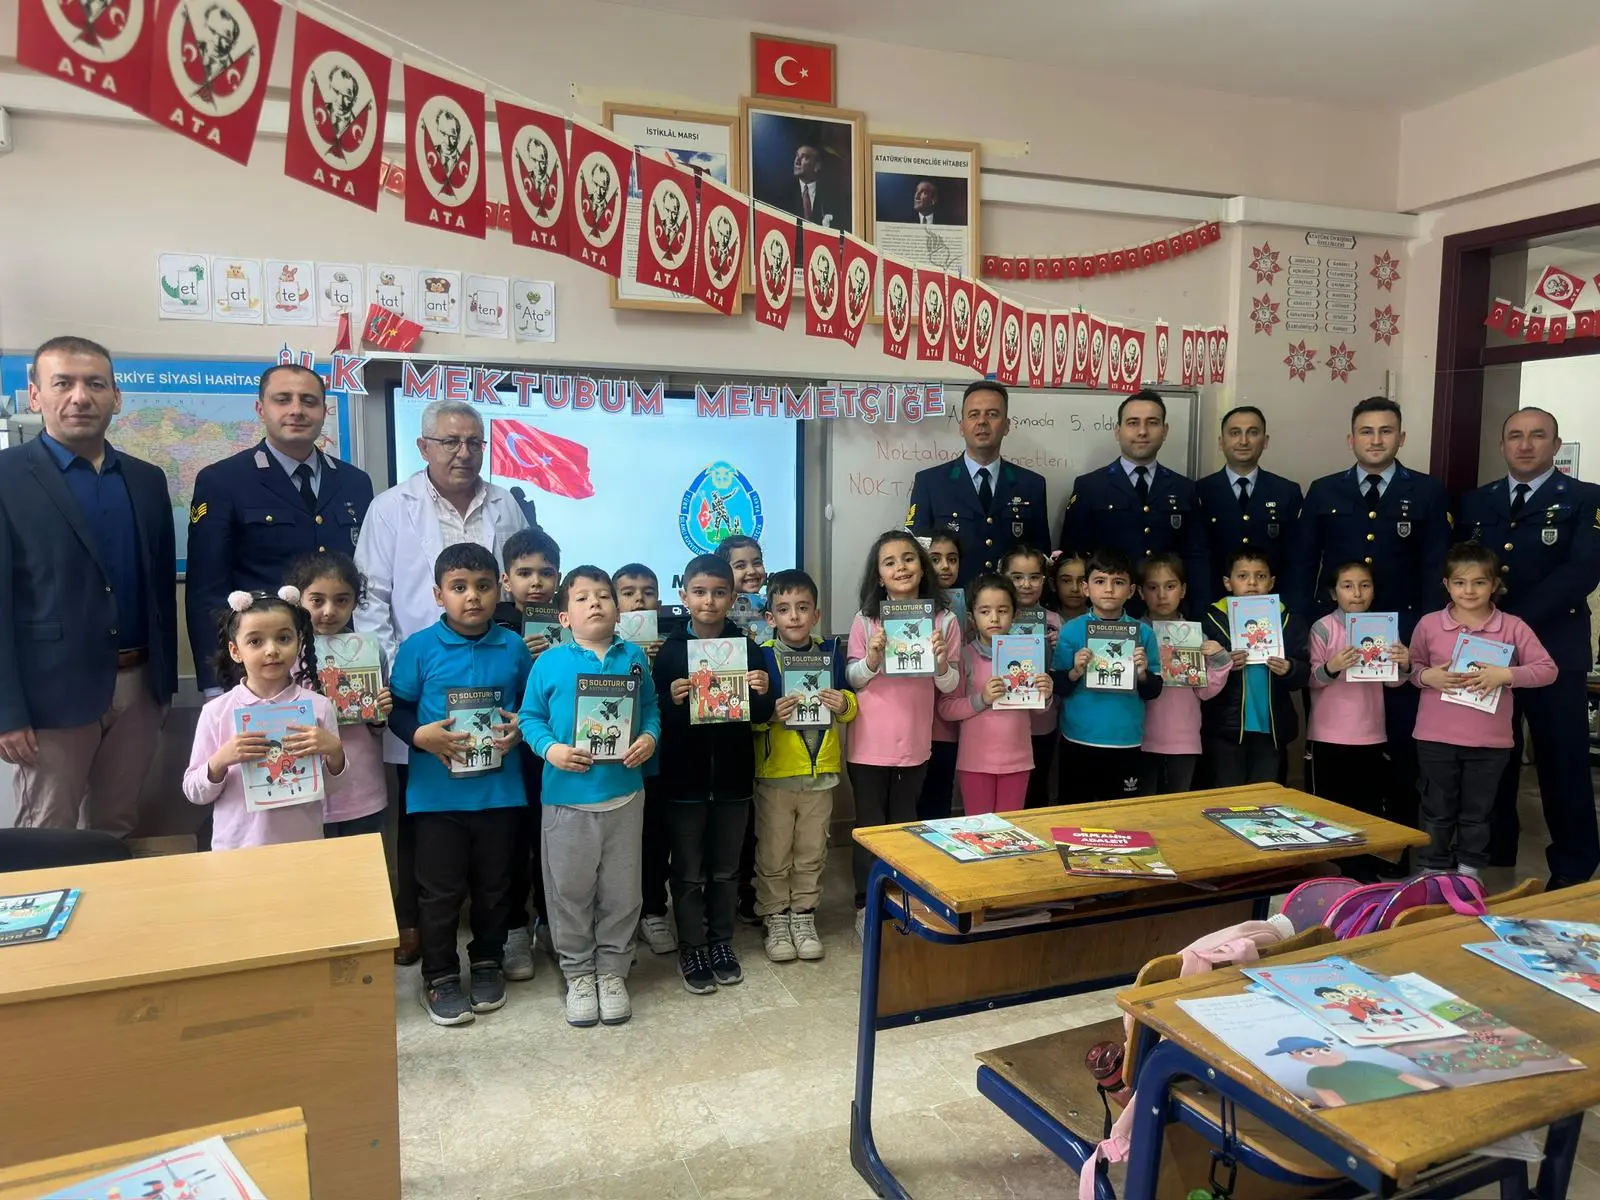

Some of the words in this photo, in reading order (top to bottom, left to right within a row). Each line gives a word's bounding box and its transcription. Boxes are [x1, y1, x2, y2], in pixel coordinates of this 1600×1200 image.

[58, 57, 118, 94] ATA
[170, 107, 221, 145] ATA
[677, 131, 699, 140] MARŞI
[942, 159, 968, 168] HİTABESİ
[313, 167, 356, 196] ATA
[429, 208, 465, 229] ATA
[531, 229, 558, 248] ATA
[582, 247, 607, 268] ATA
[654, 271, 680, 288] ATA
[180, 282, 196, 295] et
[230, 288, 246, 300] at
[282, 288, 296, 302] te
[334, 289, 349, 303] ta
[381, 294, 399, 307] tat
[705, 289, 725, 307] ATA
[427, 300, 447, 312] ant
[478, 305, 496, 316] ten
[522, 306, 544, 321] Ata
[766, 310, 783, 325] ATA
[816, 323, 833, 334] ATA
[843, 328, 856, 341] ATA
[890, 343, 902, 354] ATA
[926, 348, 939, 357] ATA
[955, 352, 966, 362] ATA
[973, 359, 983, 370] ATA
[114, 371, 155, 383] RKİYE
[160, 372, 201, 385] SİYASİ
[205, 373, 261, 386] HARİTAS
[1002, 372, 1013, 381] ATA
[402, 361, 664, 416] MEKTUBUM
[696, 384, 945, 423] MEHMETÇİĞE
[1121, 384, 1134, 392] ATA
[876, 440, 964, 460] Noktalam
[589, 679, 626, 687] SOLOTURK
[458, 691, 494, 699] SOLOTURK
